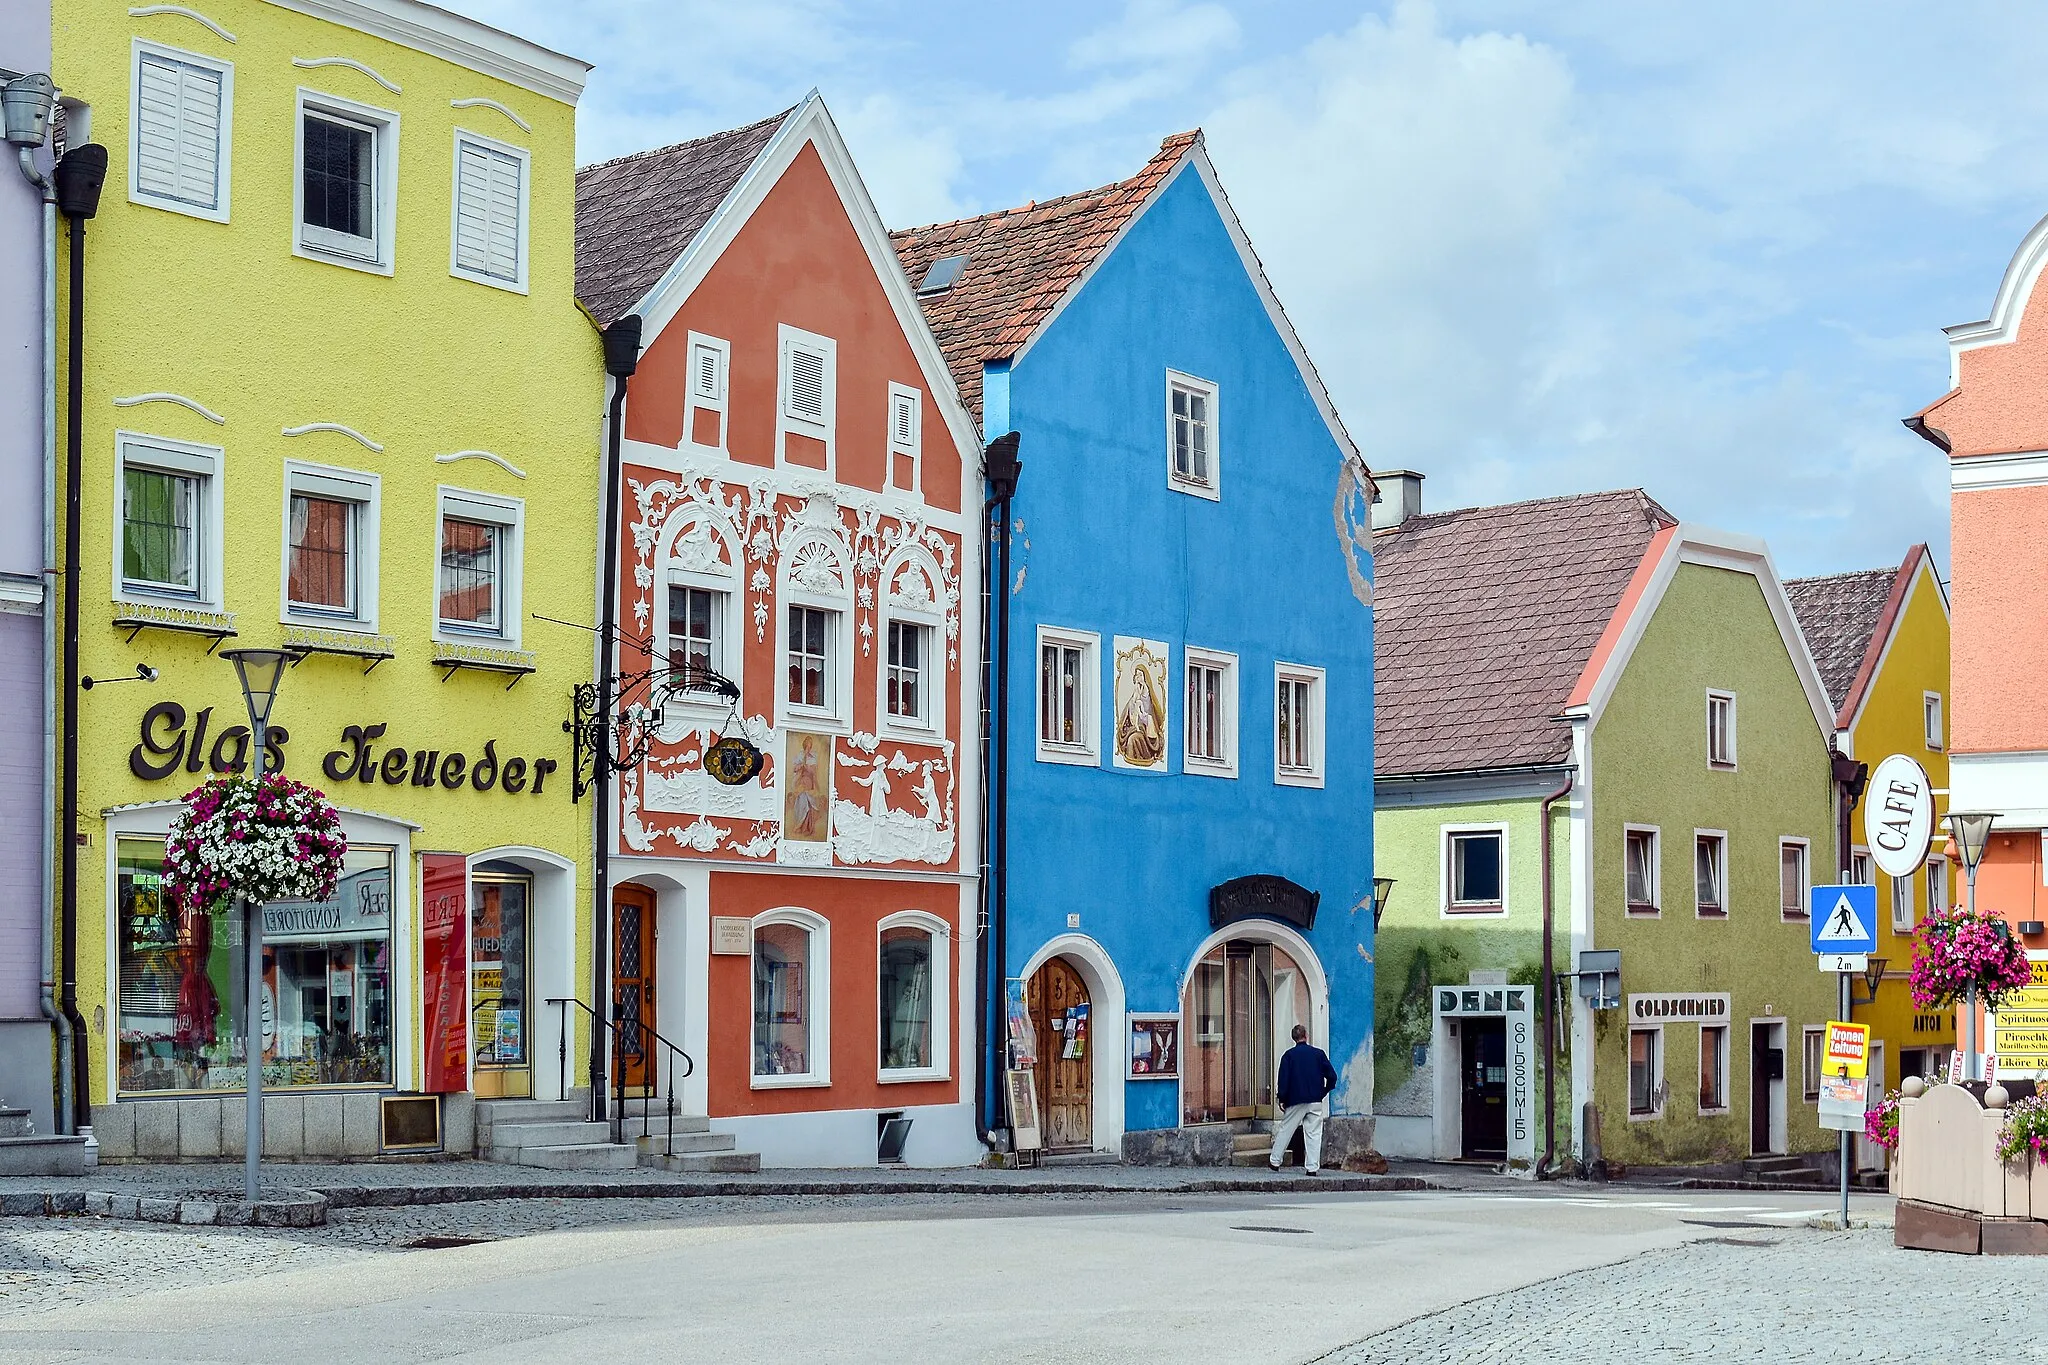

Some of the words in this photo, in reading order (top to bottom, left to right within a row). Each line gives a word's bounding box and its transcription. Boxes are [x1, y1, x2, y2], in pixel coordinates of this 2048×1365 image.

[129, 701, 290, 781] Glas
[322, 722, 558, 794] Neueder
[1877, 780, 1919, 851] CAFE
[1837, 957, 1843, 970] 2
[1844, 961, 1852, 970] m
[1440, 990, 1525, 1012] DENK
[1635, 998, 1725, 1018] GOLDSCHMIED
[1913, 1014, 1941, 1033] ANTON
[1831, 1027, 1864, 1043] Kronen
[1830, 1041, 1863, 1056] Zeitung
[1999, 1058, 2031, 1067] Liköre
[1514, 1022, 1526, 1140] GOLDSCHMIED
